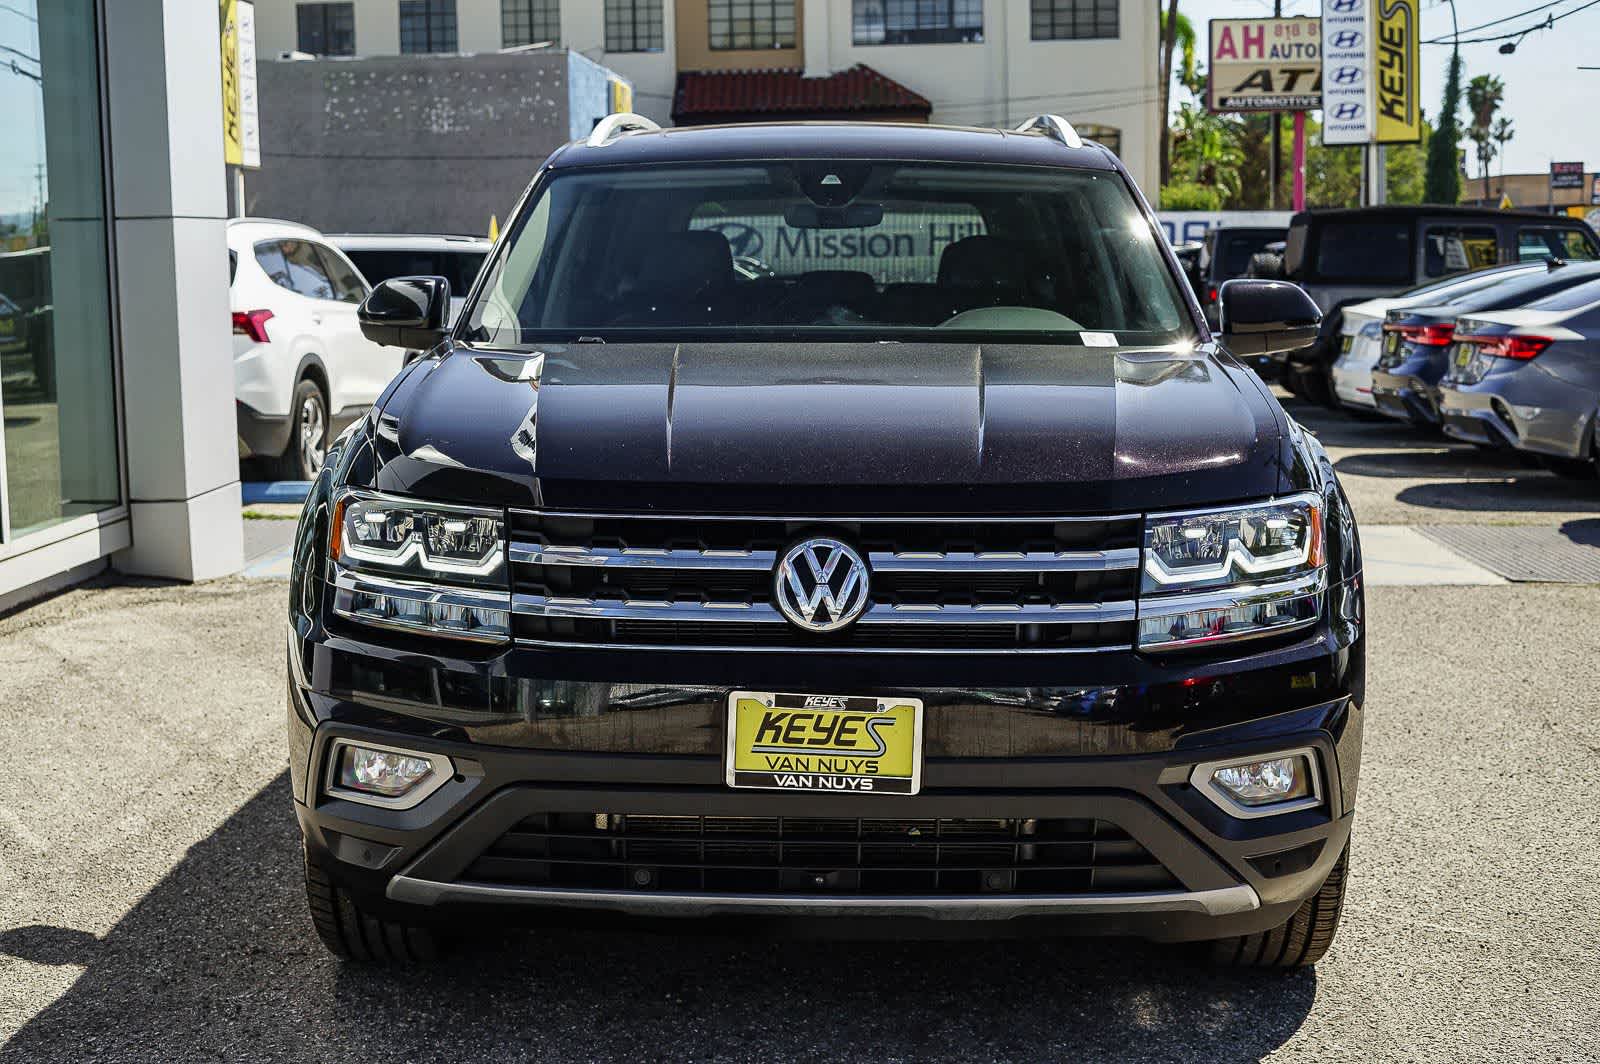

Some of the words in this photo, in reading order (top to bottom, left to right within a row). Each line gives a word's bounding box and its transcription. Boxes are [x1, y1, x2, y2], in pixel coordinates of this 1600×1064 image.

[1216, 25, 1265, 59] AH
[1270, 43, 1321, 59] AUTO
[1379, 0, 1413, 127] KEYES
[1225, 96, 1320, 108] AUTOMOTIVE
[775, 224, 913, 259] Mission
[803, 696, 849, 710] KEYES
[752, 712, 896, 757] KEYES
[765, 756, 810, 772] VAN
[818, 758, 879, 774] NUYS
[774, 774, 813, 788] VAN
[818, 777, 873, 791] NUYS
